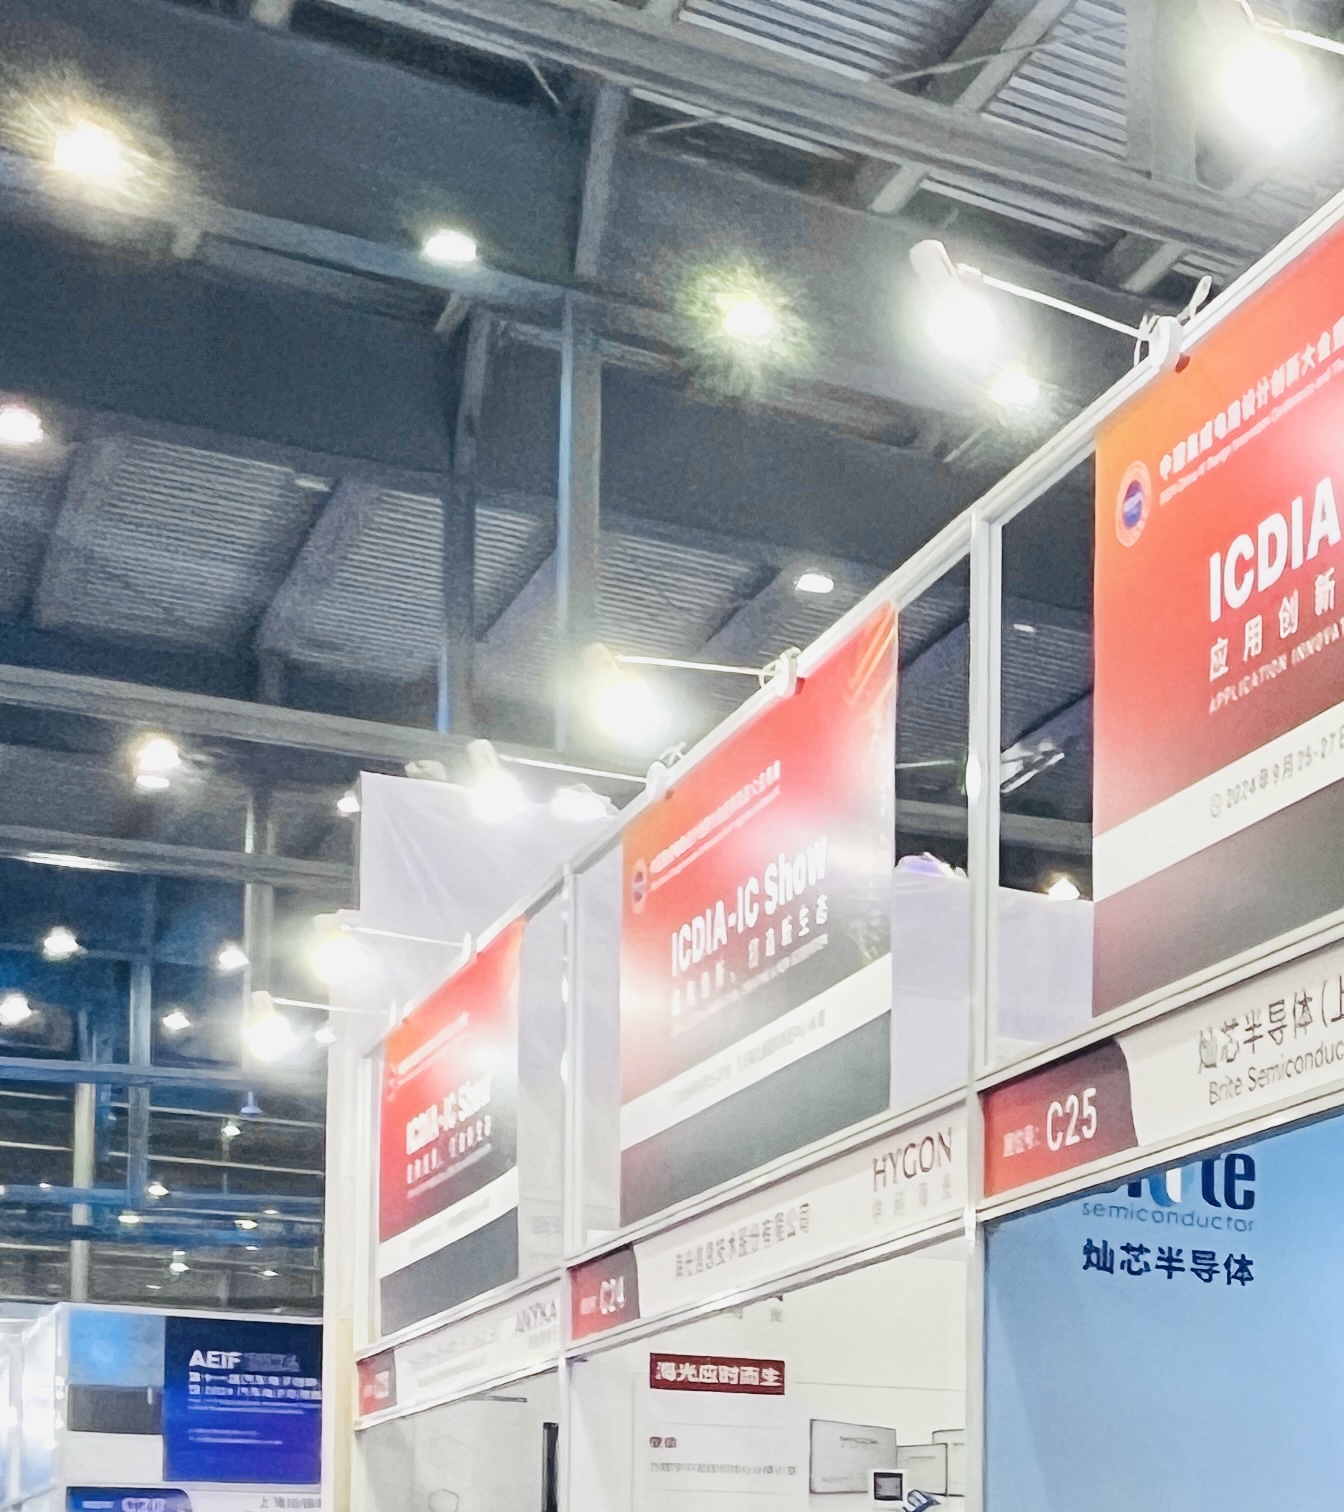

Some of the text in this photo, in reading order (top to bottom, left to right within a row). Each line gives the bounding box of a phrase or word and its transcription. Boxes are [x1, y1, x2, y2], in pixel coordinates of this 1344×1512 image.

[672, 876, 759, 977] ICDIA-IC
[764, 835, 827, 915] Show
[1046, 1087, 1097, 1152] C25
[872, 1127, 952, 1192] HYGON
[1082, 1201, 1253, 1233] semiconductor
[1082, 1238, 1254, 1287] 灿芯半导体
